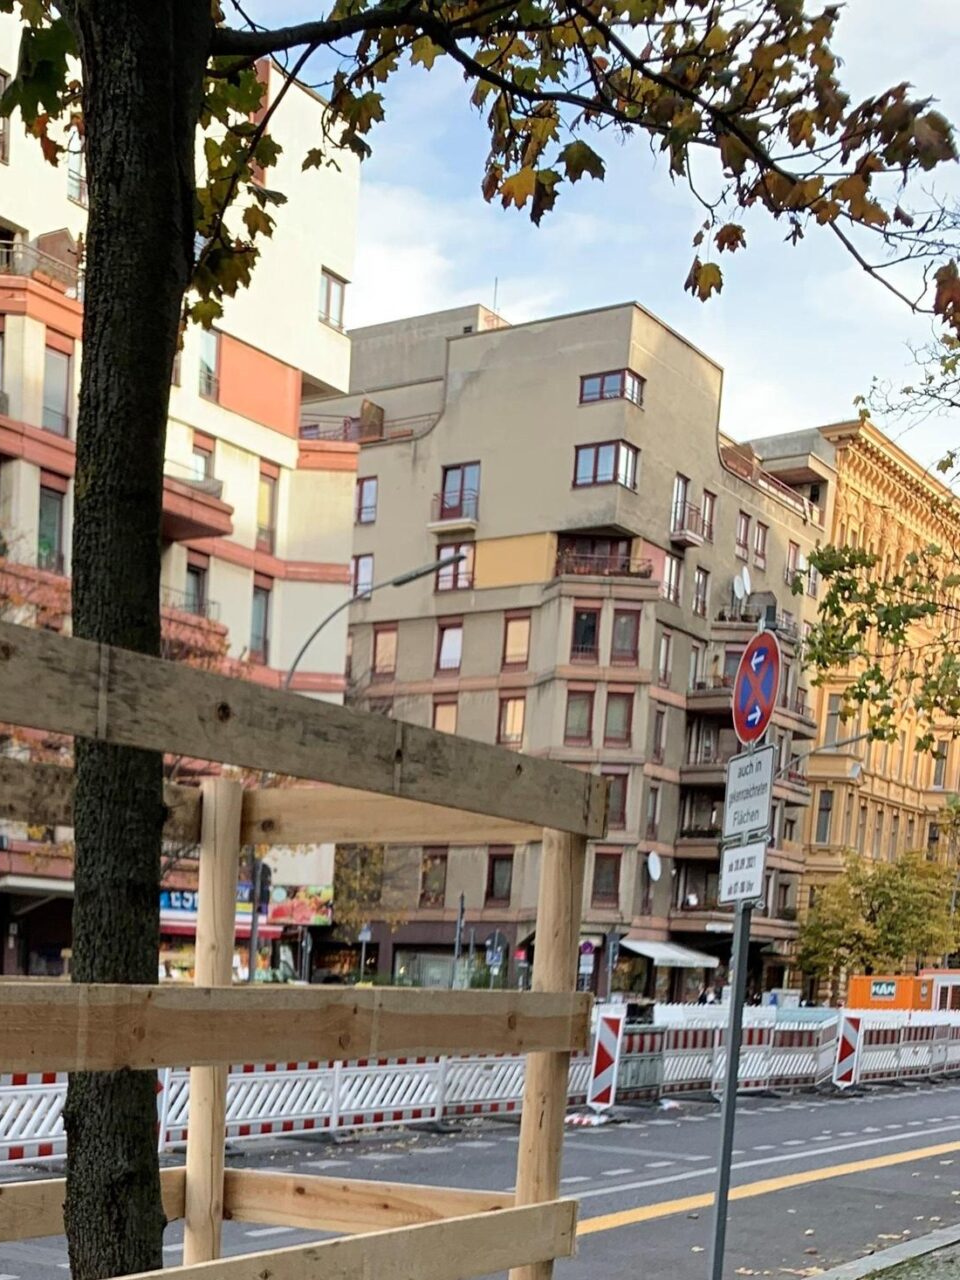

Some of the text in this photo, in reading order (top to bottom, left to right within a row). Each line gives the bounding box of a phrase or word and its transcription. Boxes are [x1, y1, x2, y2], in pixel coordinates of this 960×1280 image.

[737, 758, 762, 779] auch in
[732, 809, 760, 828] Flächen
